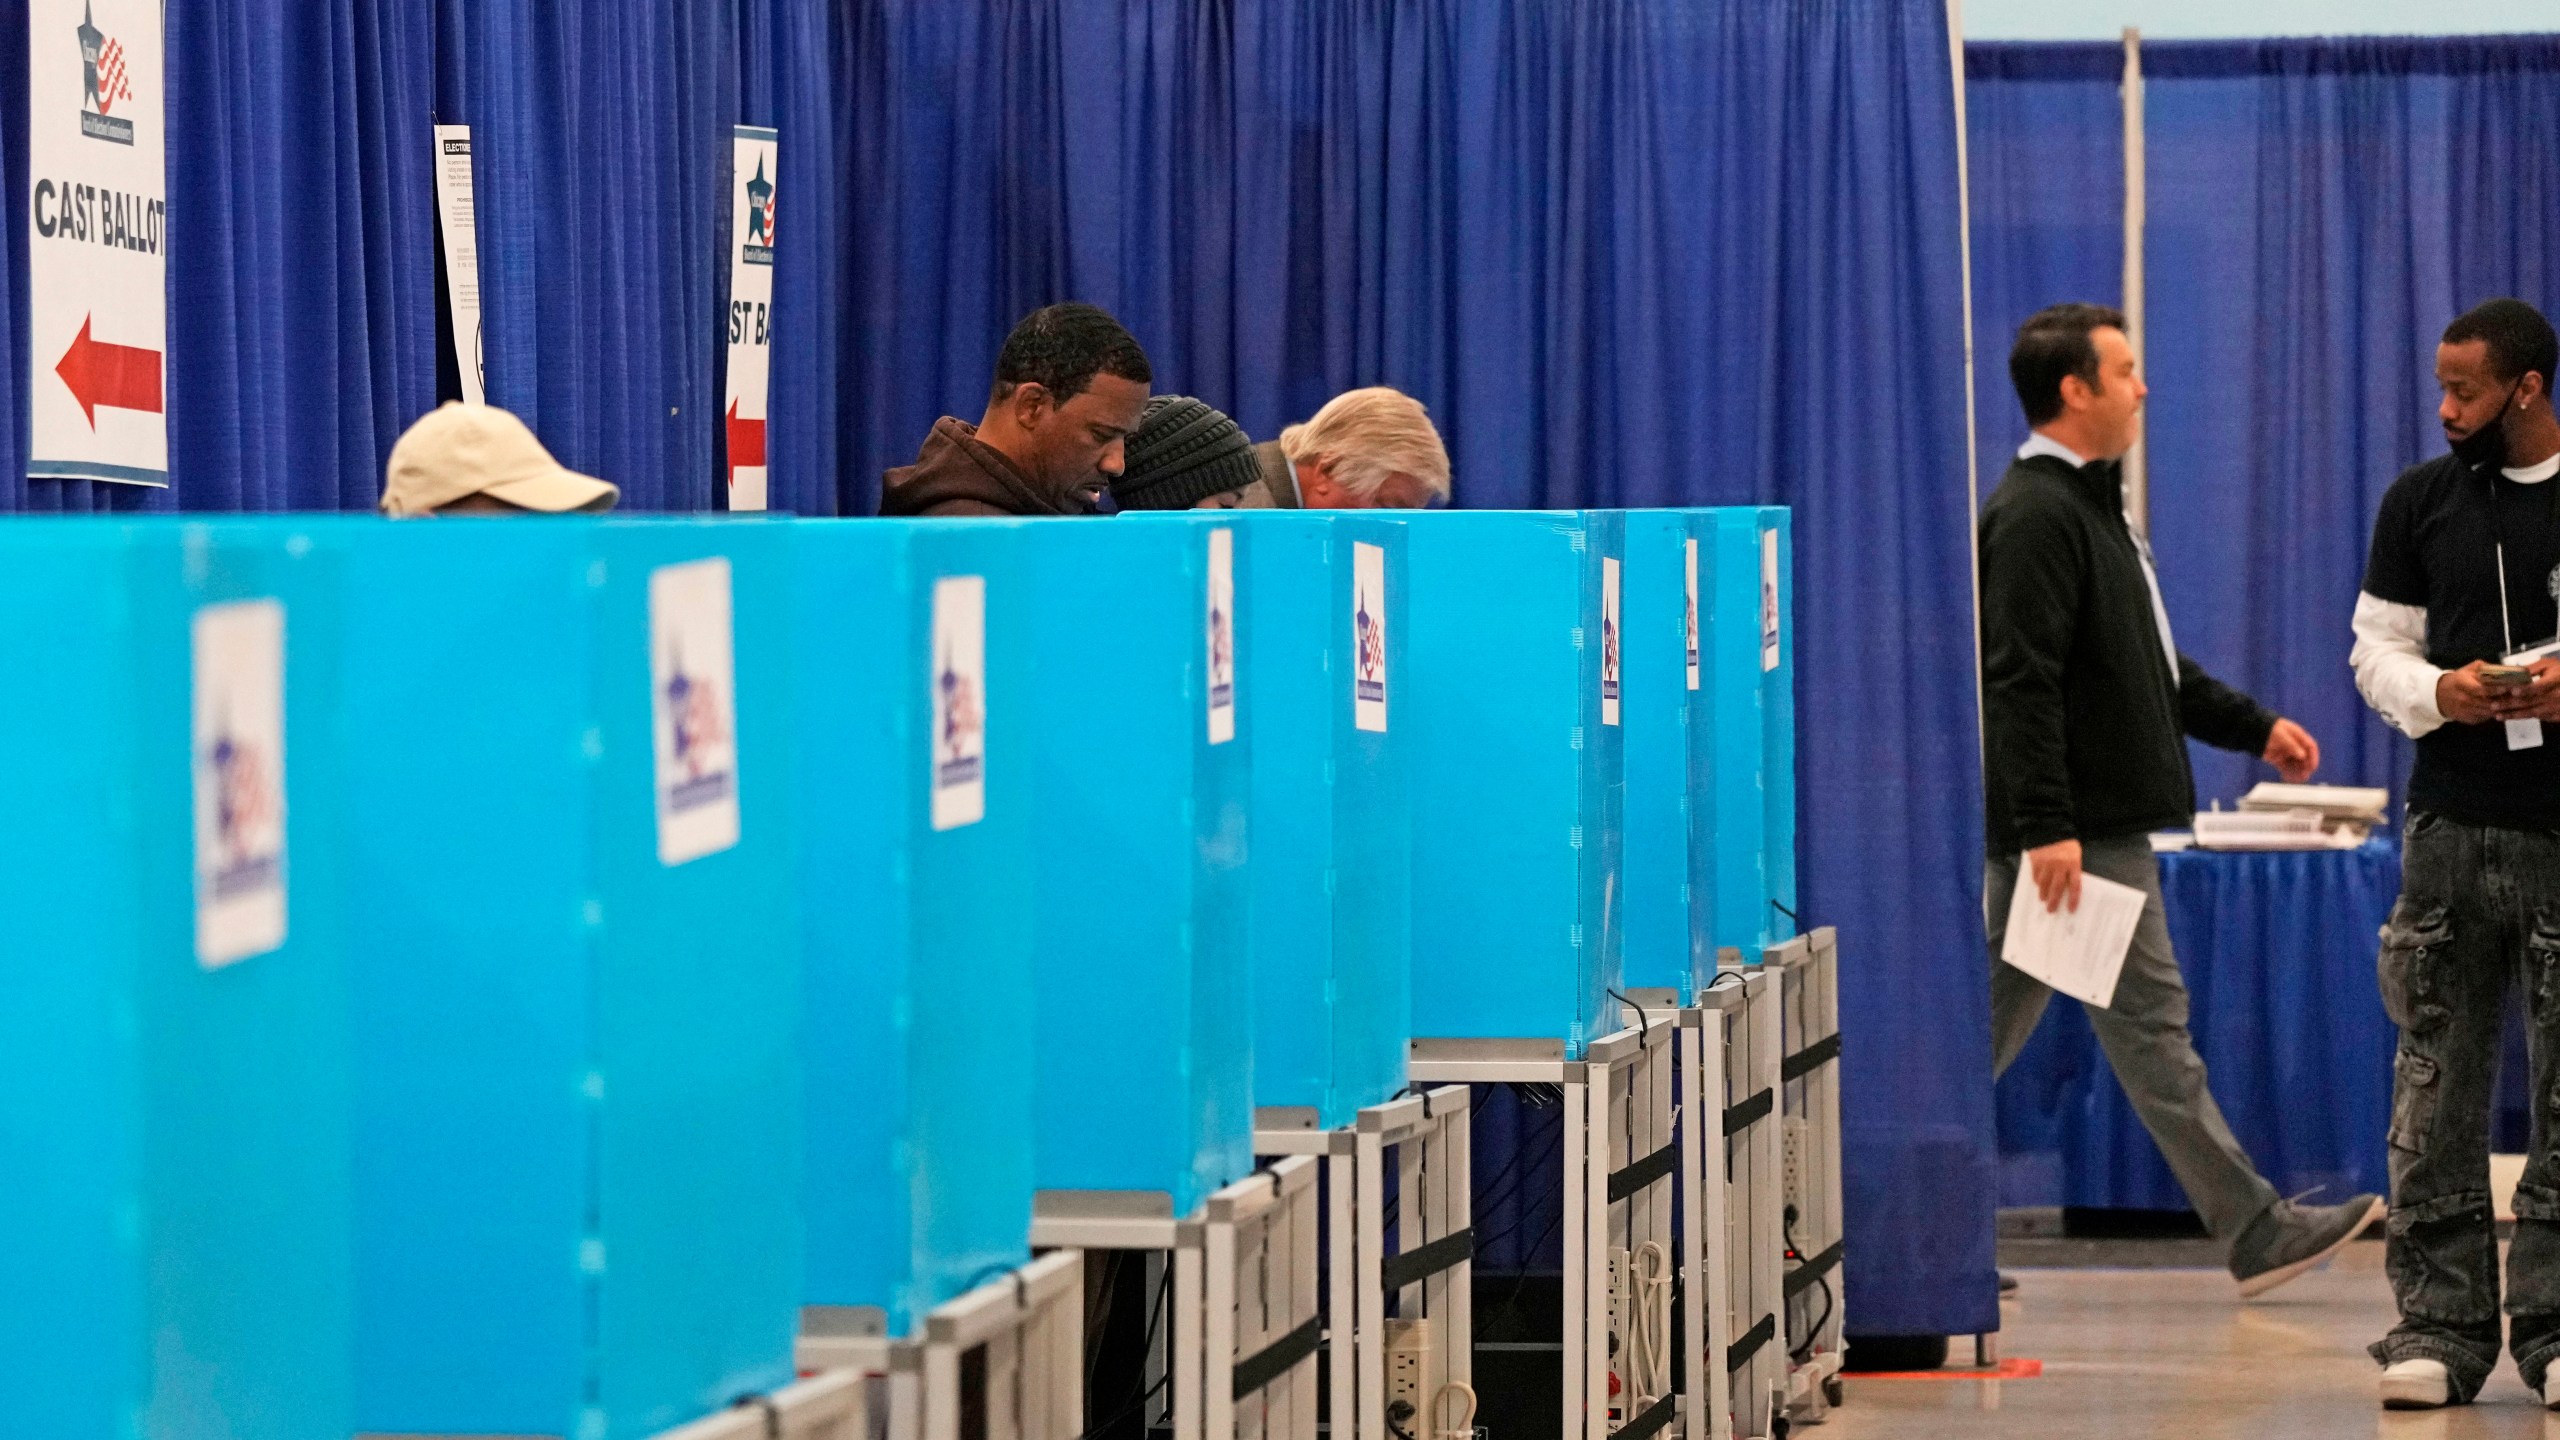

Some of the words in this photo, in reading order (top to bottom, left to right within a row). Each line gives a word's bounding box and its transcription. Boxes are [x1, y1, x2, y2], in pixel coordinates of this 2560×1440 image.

[35, 178, 96, 244] CAST
[101, 188, 165, 257] BALLOT
[728, 300, 752, 345] ST
